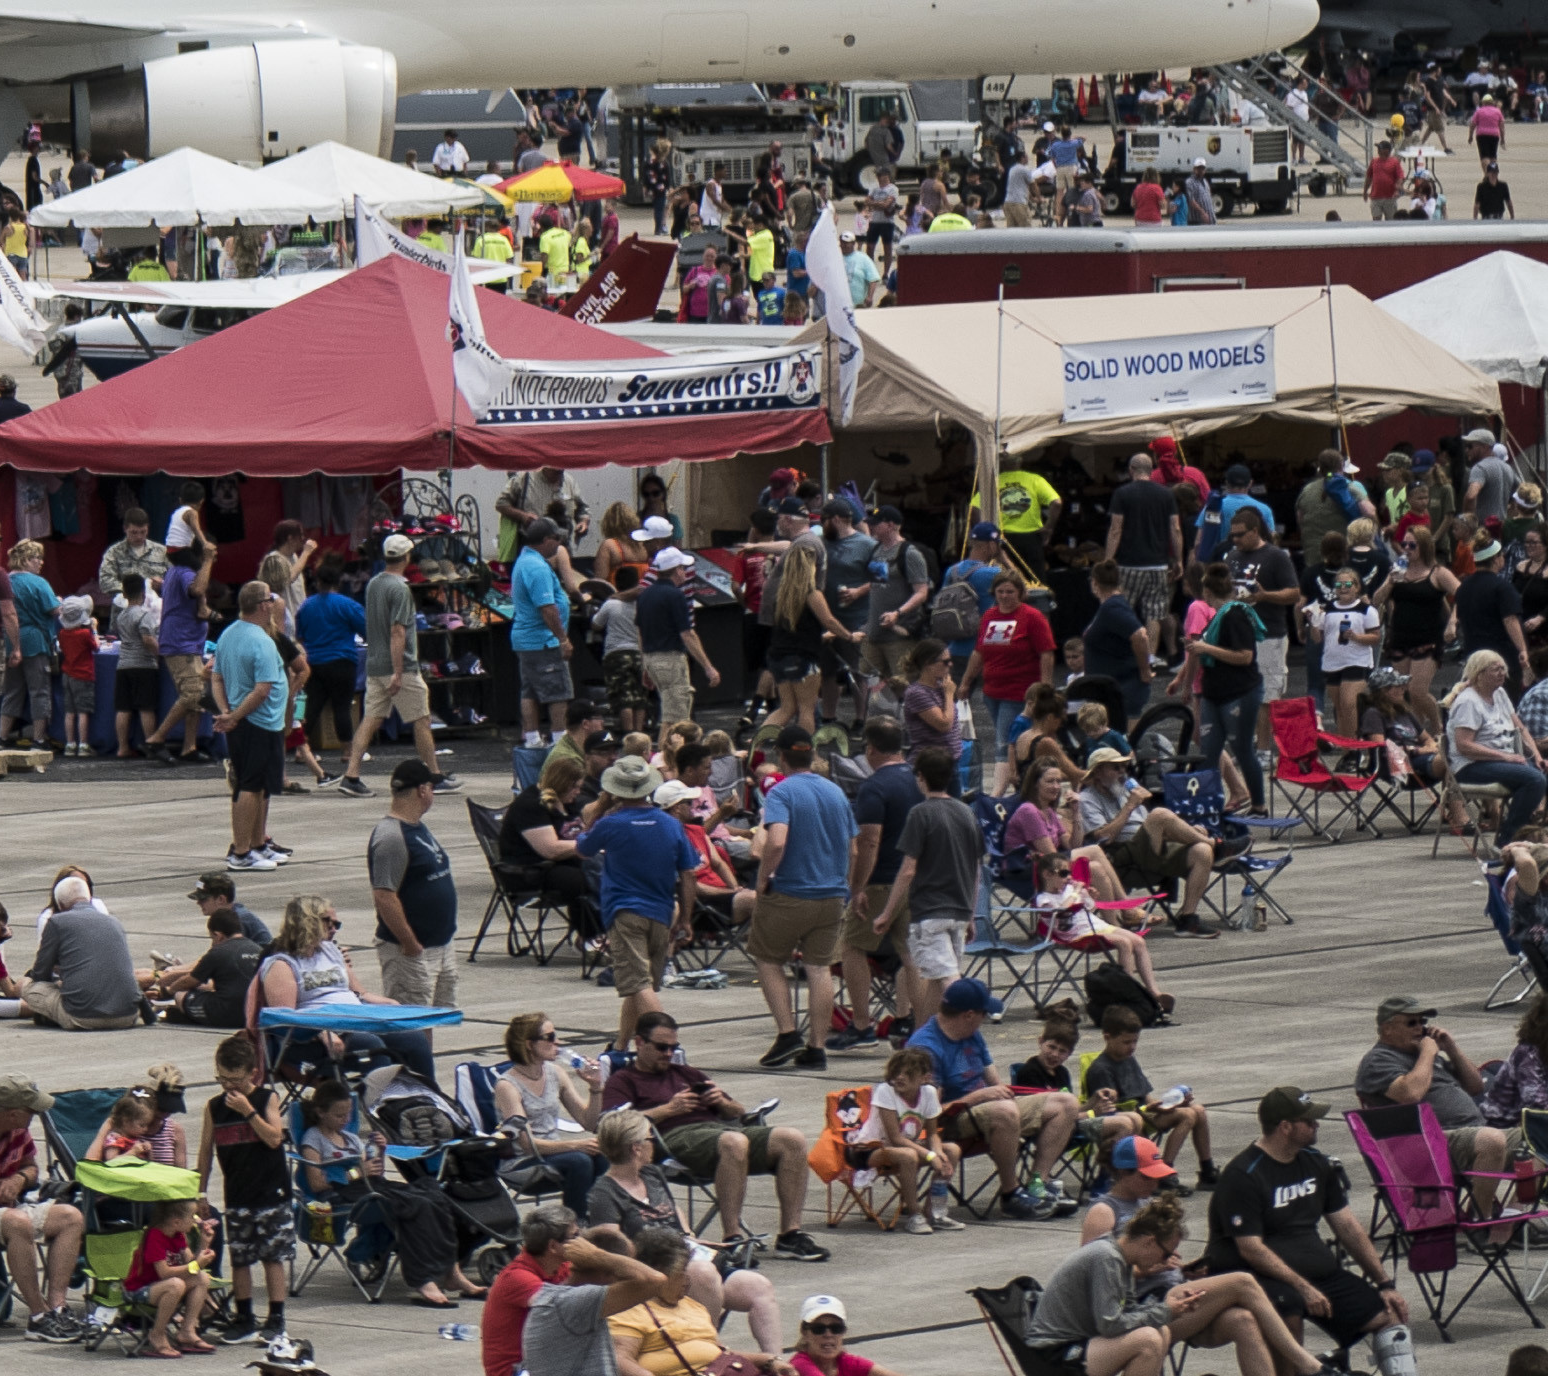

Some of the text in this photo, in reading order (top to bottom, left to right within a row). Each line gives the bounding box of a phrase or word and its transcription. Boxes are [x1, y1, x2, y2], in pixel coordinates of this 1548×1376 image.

[573, 270, 620, 325] CIVIL AIR
[1065, 344, 1266, 382] SOLID WOOD MODELS
[1274, 1178, 1317, 1208] LIONS
